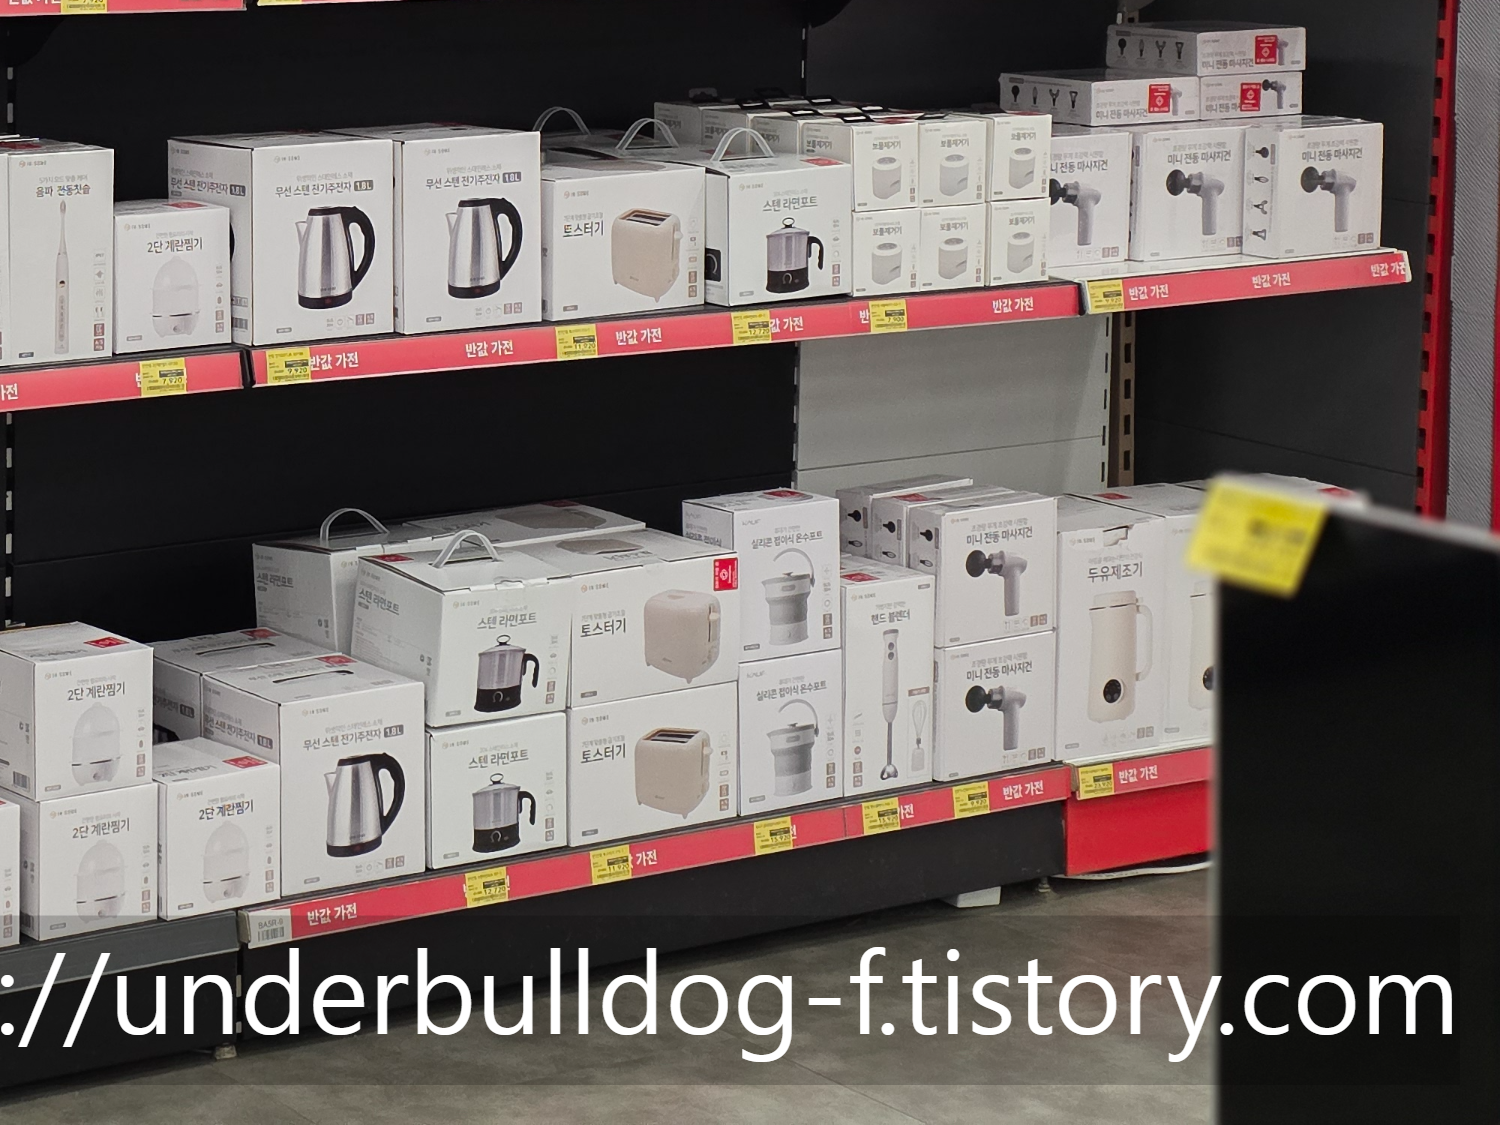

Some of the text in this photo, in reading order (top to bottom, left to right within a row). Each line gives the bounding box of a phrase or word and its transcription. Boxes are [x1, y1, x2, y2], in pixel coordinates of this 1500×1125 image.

[1168, 150, 1231, 165] 미니 전동 마사지건
[426, 173, 500, 189] 무선 스텐 전기주전자
[763, 195, 818, 212] 스텐 라면포트
[147, 236, 204, 254] 2단 계란찜기
[992, 297, 1034, 314] 반값 가전
[466, 339, 514, 357] 반값 가전
[773, 534, 795, 547] 접이식
[1087, 562, 1143, 583] 두유제조기
[580, 618, 626, 637] 토스터기
[304, 731, 382, 750] 무선 스텐 전기주전자
[469, 749, 529, 769] 스텐 라면포트
[1003, 780, 1044, 800] 반값 가전
[307, 902, 357, 927] 반값 가전
